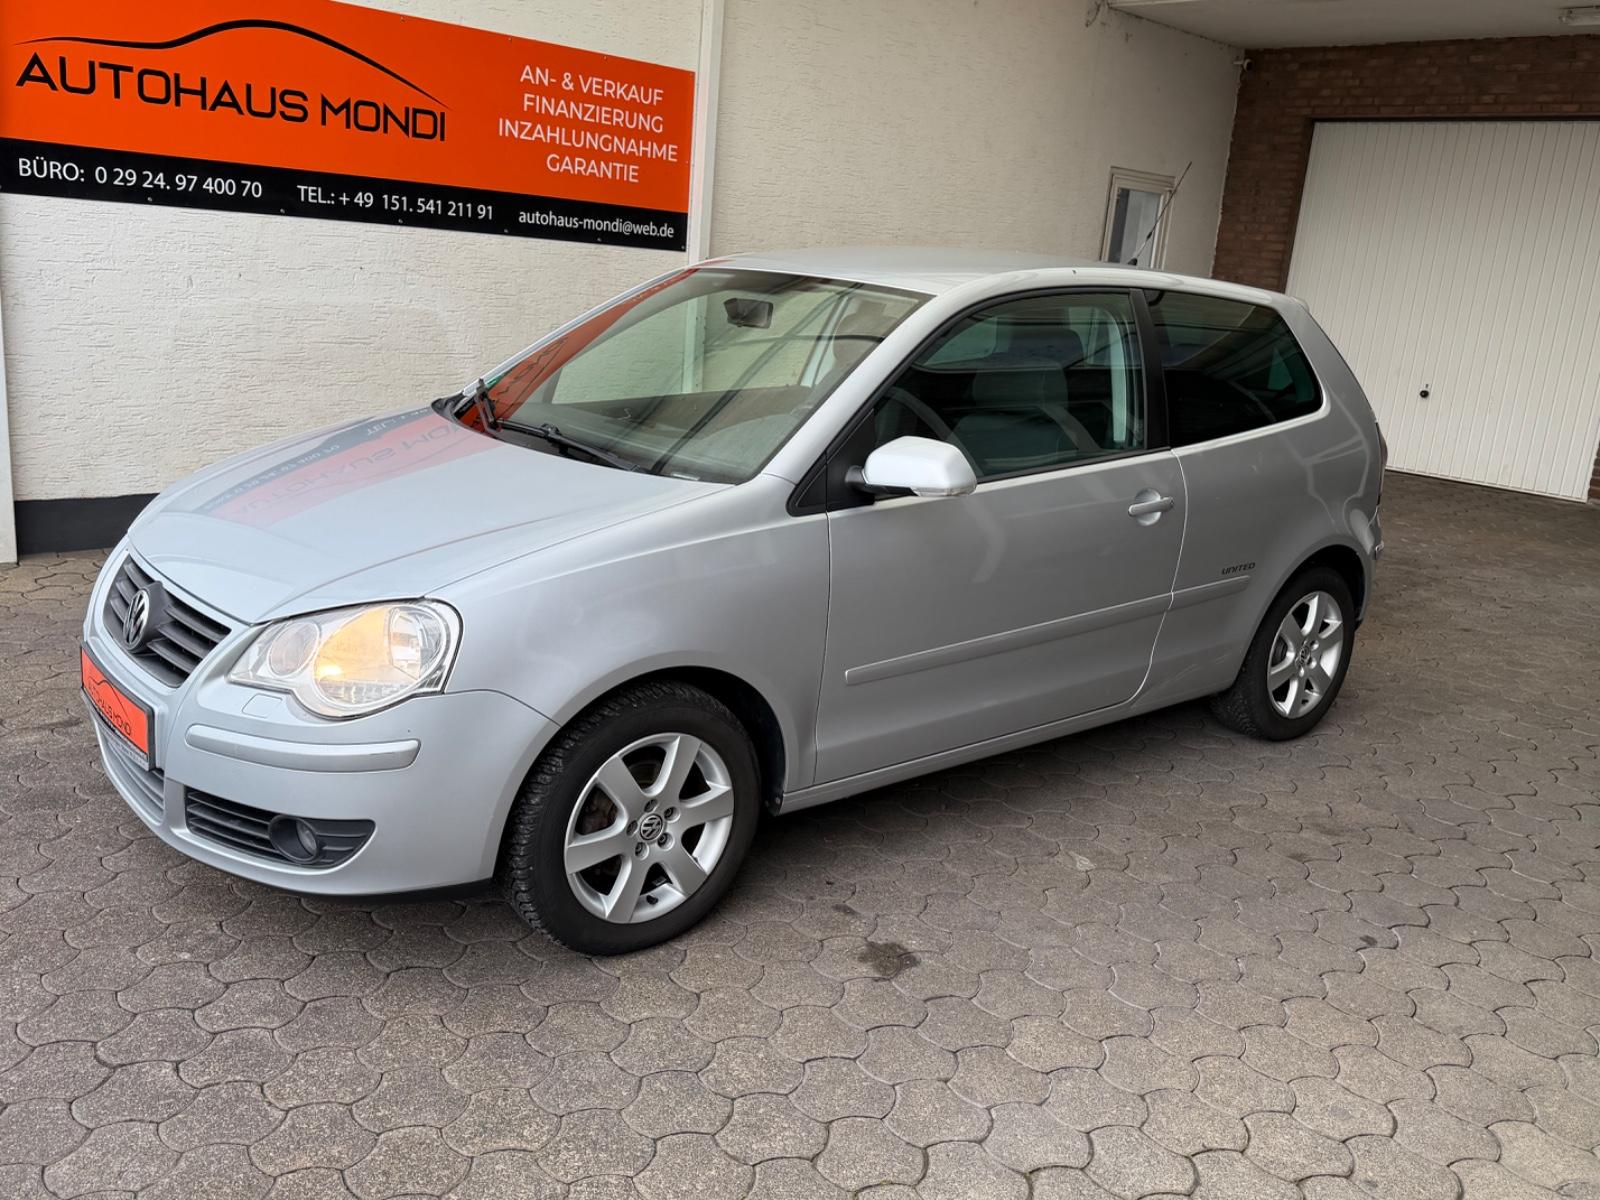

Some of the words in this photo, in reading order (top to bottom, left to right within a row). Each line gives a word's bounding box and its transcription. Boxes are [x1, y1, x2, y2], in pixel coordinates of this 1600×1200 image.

[15, 51, 309, 123] AUTOHAUS
[320, 93, 446, 142] MONDI
[520, 64, 557, 87] AN-
[561, 71, 575, 92] &
[579, 74, 665, 107] VERKAUF
[523, 93, 664, 134] FINANZIERUNG
[499, 117, 679, 163] INZAHLUNGNAHME
[18, 155, 85, 182] BÜRO:
[94, 166, 108, 185] 0
[112, 167, 137, 187] 29
[142, 170, 171, 190] 24.
[175, 174, 198, 192] 97
[202, 177, 237, 196] 400
[240, 180, 262, 198] 70
[546, 153, 640, 184] GARANTIE
[296, 185, 335, 205] TEL.:
[382, 194, 414, 213] 151.
[417, 197, 443, 215] 541
[447, 201, 472, 218] 211
[476, 204, 493, 220] 91
[518, 209, 675, 239] autohaus-mondi@web.de
[1221, 562, 1256, 575] UNITED
